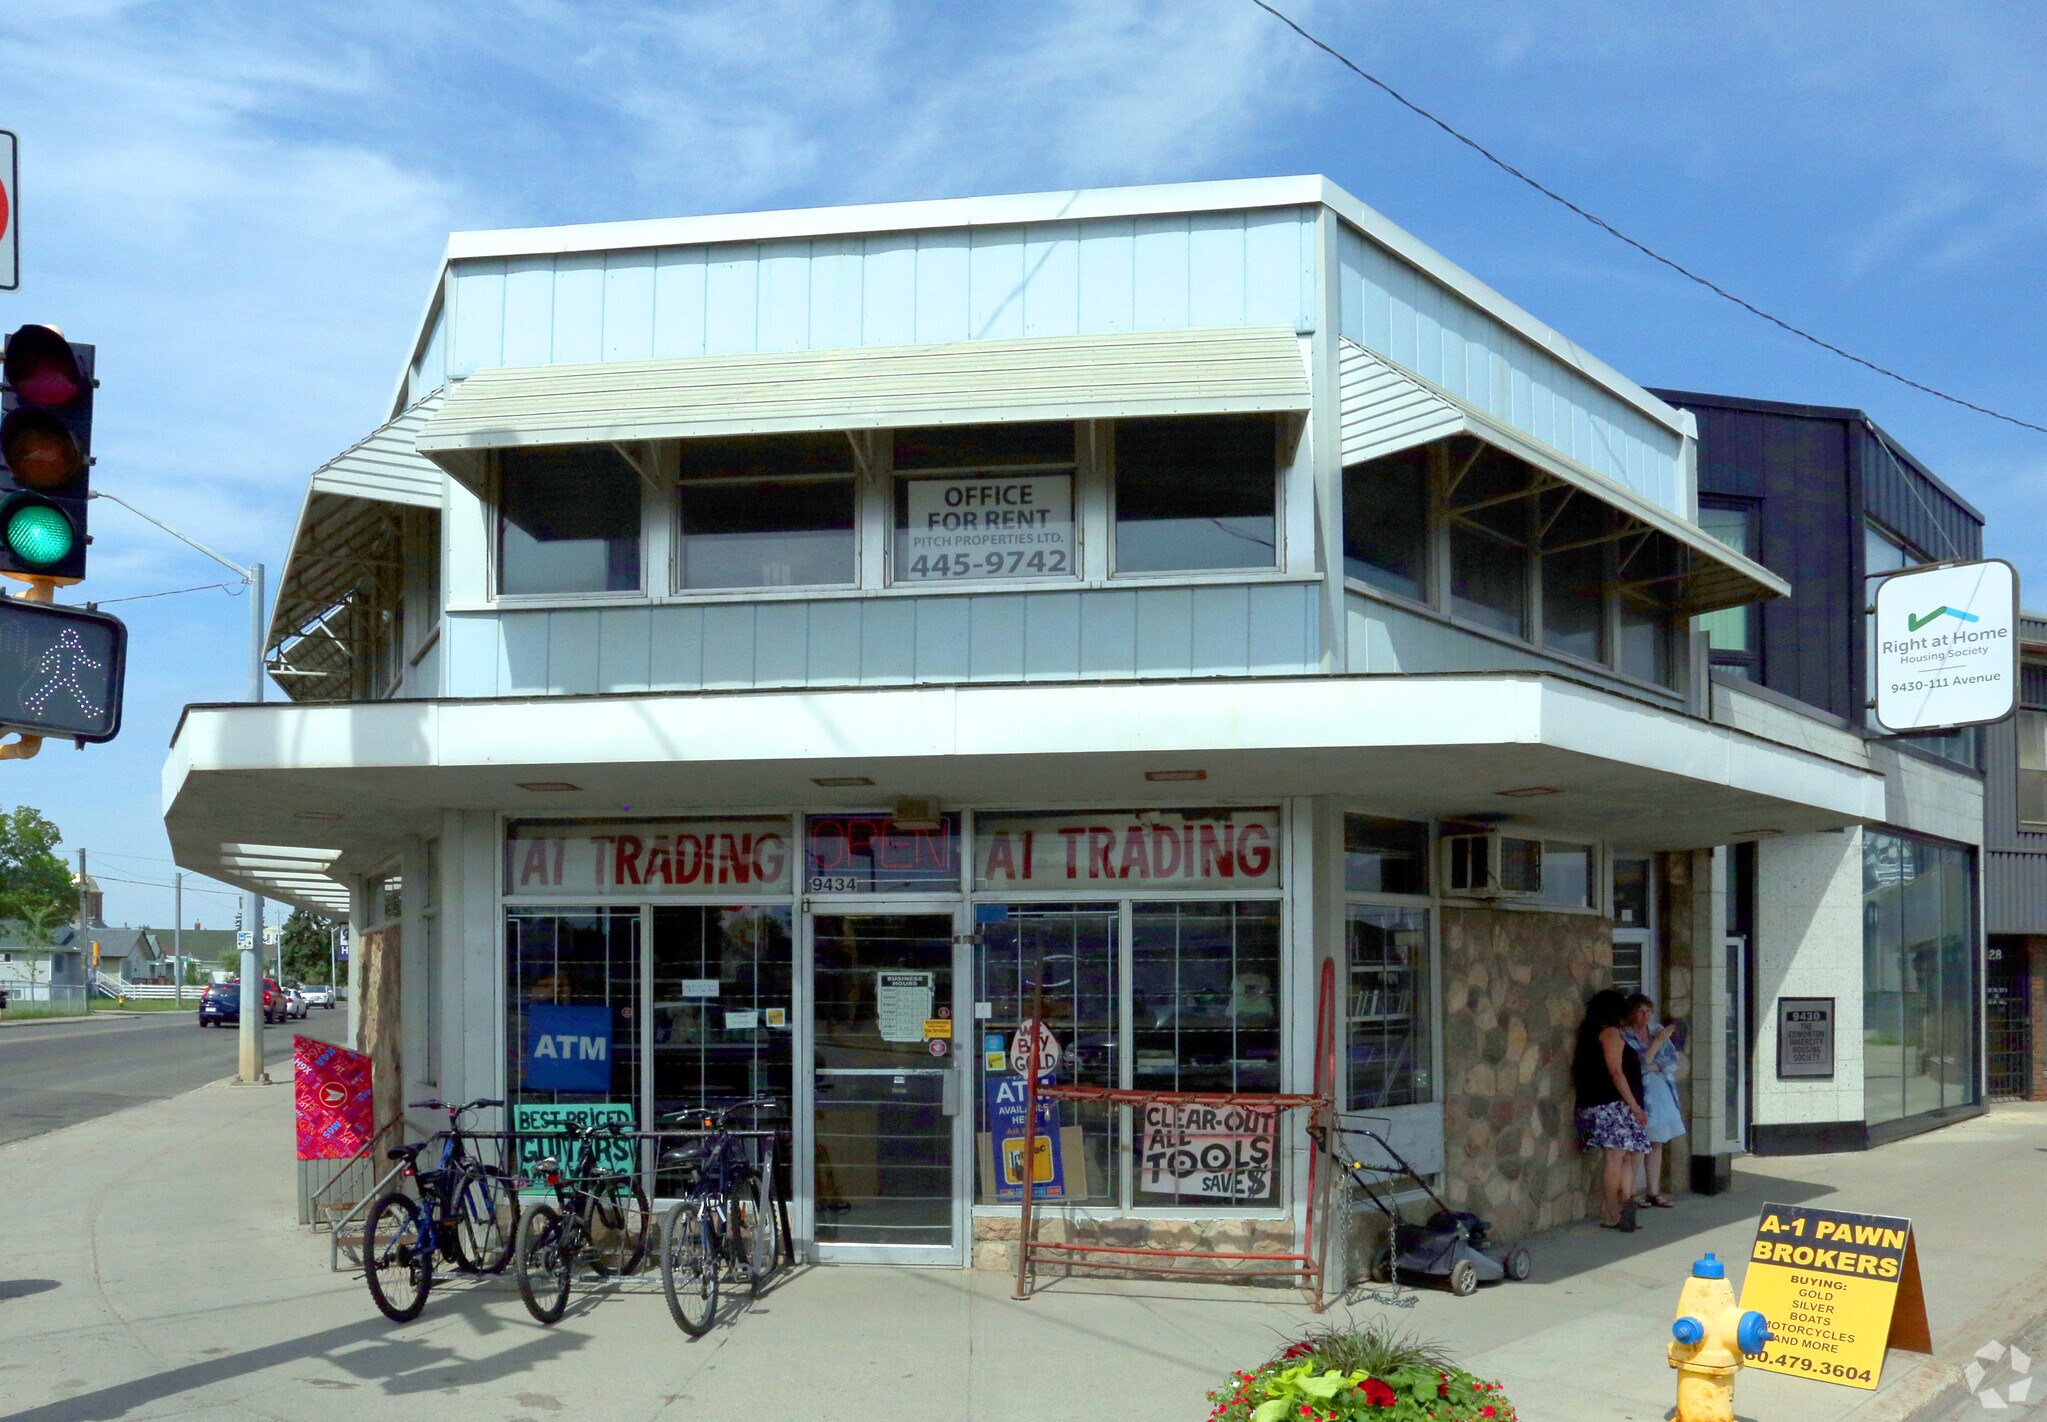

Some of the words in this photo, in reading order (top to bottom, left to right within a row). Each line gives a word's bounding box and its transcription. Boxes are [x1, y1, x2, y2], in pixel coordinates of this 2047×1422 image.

[944, 485, 1033, 507] OFFICE
[928, 511, 978, 532] FOR
[985, 509, 1051, 530] RENT
[913, 536, 951, 548] PITCH
[955, 533, 1034, 546] PROPERTIES
[1037, 532, 1064, 543] LTD.
[910, 549, 1067, 578] 445-9742
[1882, 637, 1927, 655] Right
[1932, 634, 1949, 648] at
[1953, 627, 2008, 645] Home
[1900, 651, 1945, 665] Housing
[1948, 646, 1989, 658] Society
[1891, 677, 1949, 693] 9430-111
[1953, 672, 2001, 686] Avenue
[813, 819, 947, 868] OPEN
[1058, 823, 1274, 879] TRADING
[591, 832, 785, 885] TRADING
[812, 877, 857, 891] 9434
[1792, 1011, 1820, 1021] 9430
[534, 1034, 606, 1061] ATM
[1018, 1036, 1050, 1054] BY
[1792, 1046, 1822, 1054] HOUSING
[1793, 1054, 1820, 1062] SOCIETY
[996, 1079, 1050, 1104] AT
[519, 1111, 561, 1130] BEST
[1146, 1107, 1273, 1133] CLEAR-OUT
[1148, 1128, 1192, 1151] ALL
[1146, 1136, 1270, 1184] TOOLS
[1760, 1214, 1806, 1237] A-1
[1815, 1220, 1905, 1249] PAWN
[1752, 1240, 1899, 1278] BROKERS
[1790, 1275, 1847, 1291] BUYING:
[1799, 1288, 1834, 1301] GOLD
[1792, 1300, 1835, 1314] SILVER
[1790, 1312, 1831, 1326] BOATS
[1773, 1335, 1799, 1346] AND
[1802, 1340, 1839, 1354] MORE
